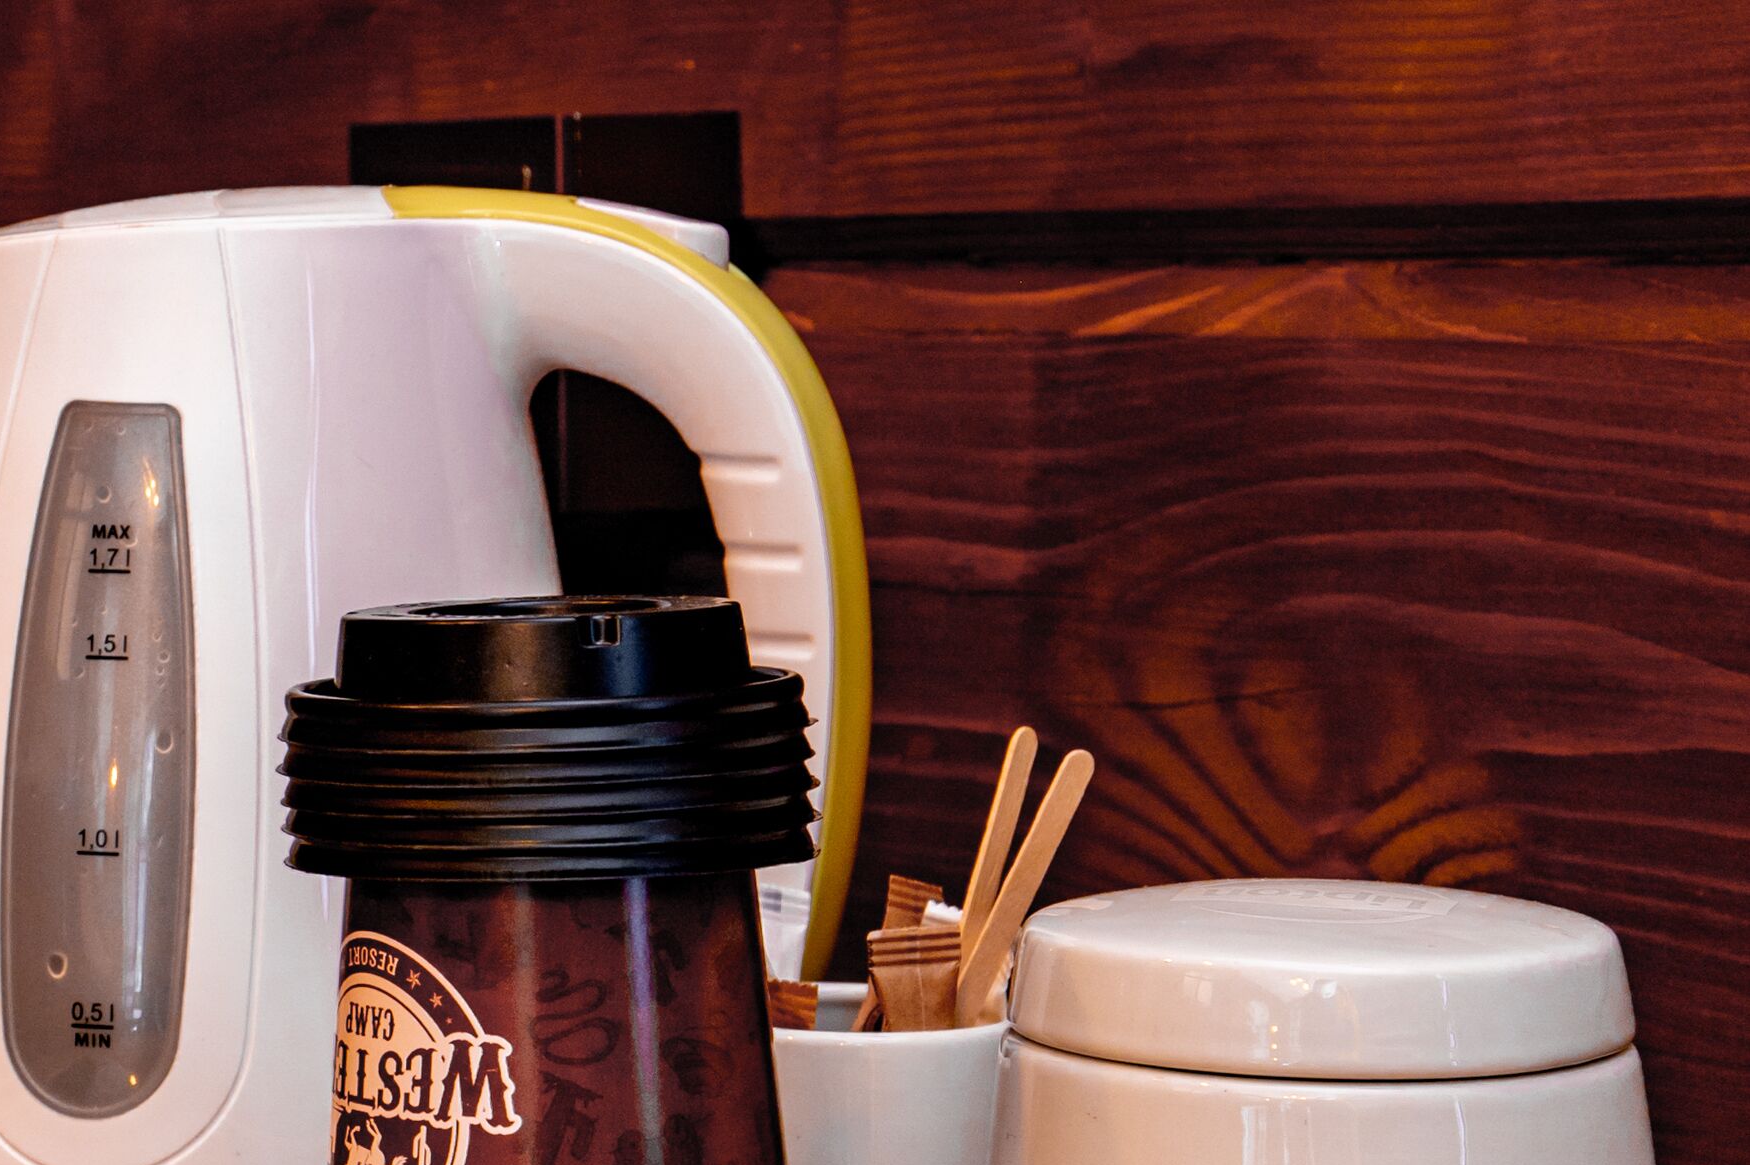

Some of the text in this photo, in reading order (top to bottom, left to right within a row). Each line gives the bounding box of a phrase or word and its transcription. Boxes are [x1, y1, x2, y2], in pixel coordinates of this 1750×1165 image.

[92, 524, 130, 540] MAX
[90, 548, 119, 568] 1,7
[87, 634, 116, 655] 1,5
[78, 828, 108, 850] 1,0
[1202, 886, 1428, 910] Lipton
[71, 1001, 103, 1023] 0,5
[346, 1001, 395, 1041] CAMP
[74, 1032, 111, 1048] MIN
